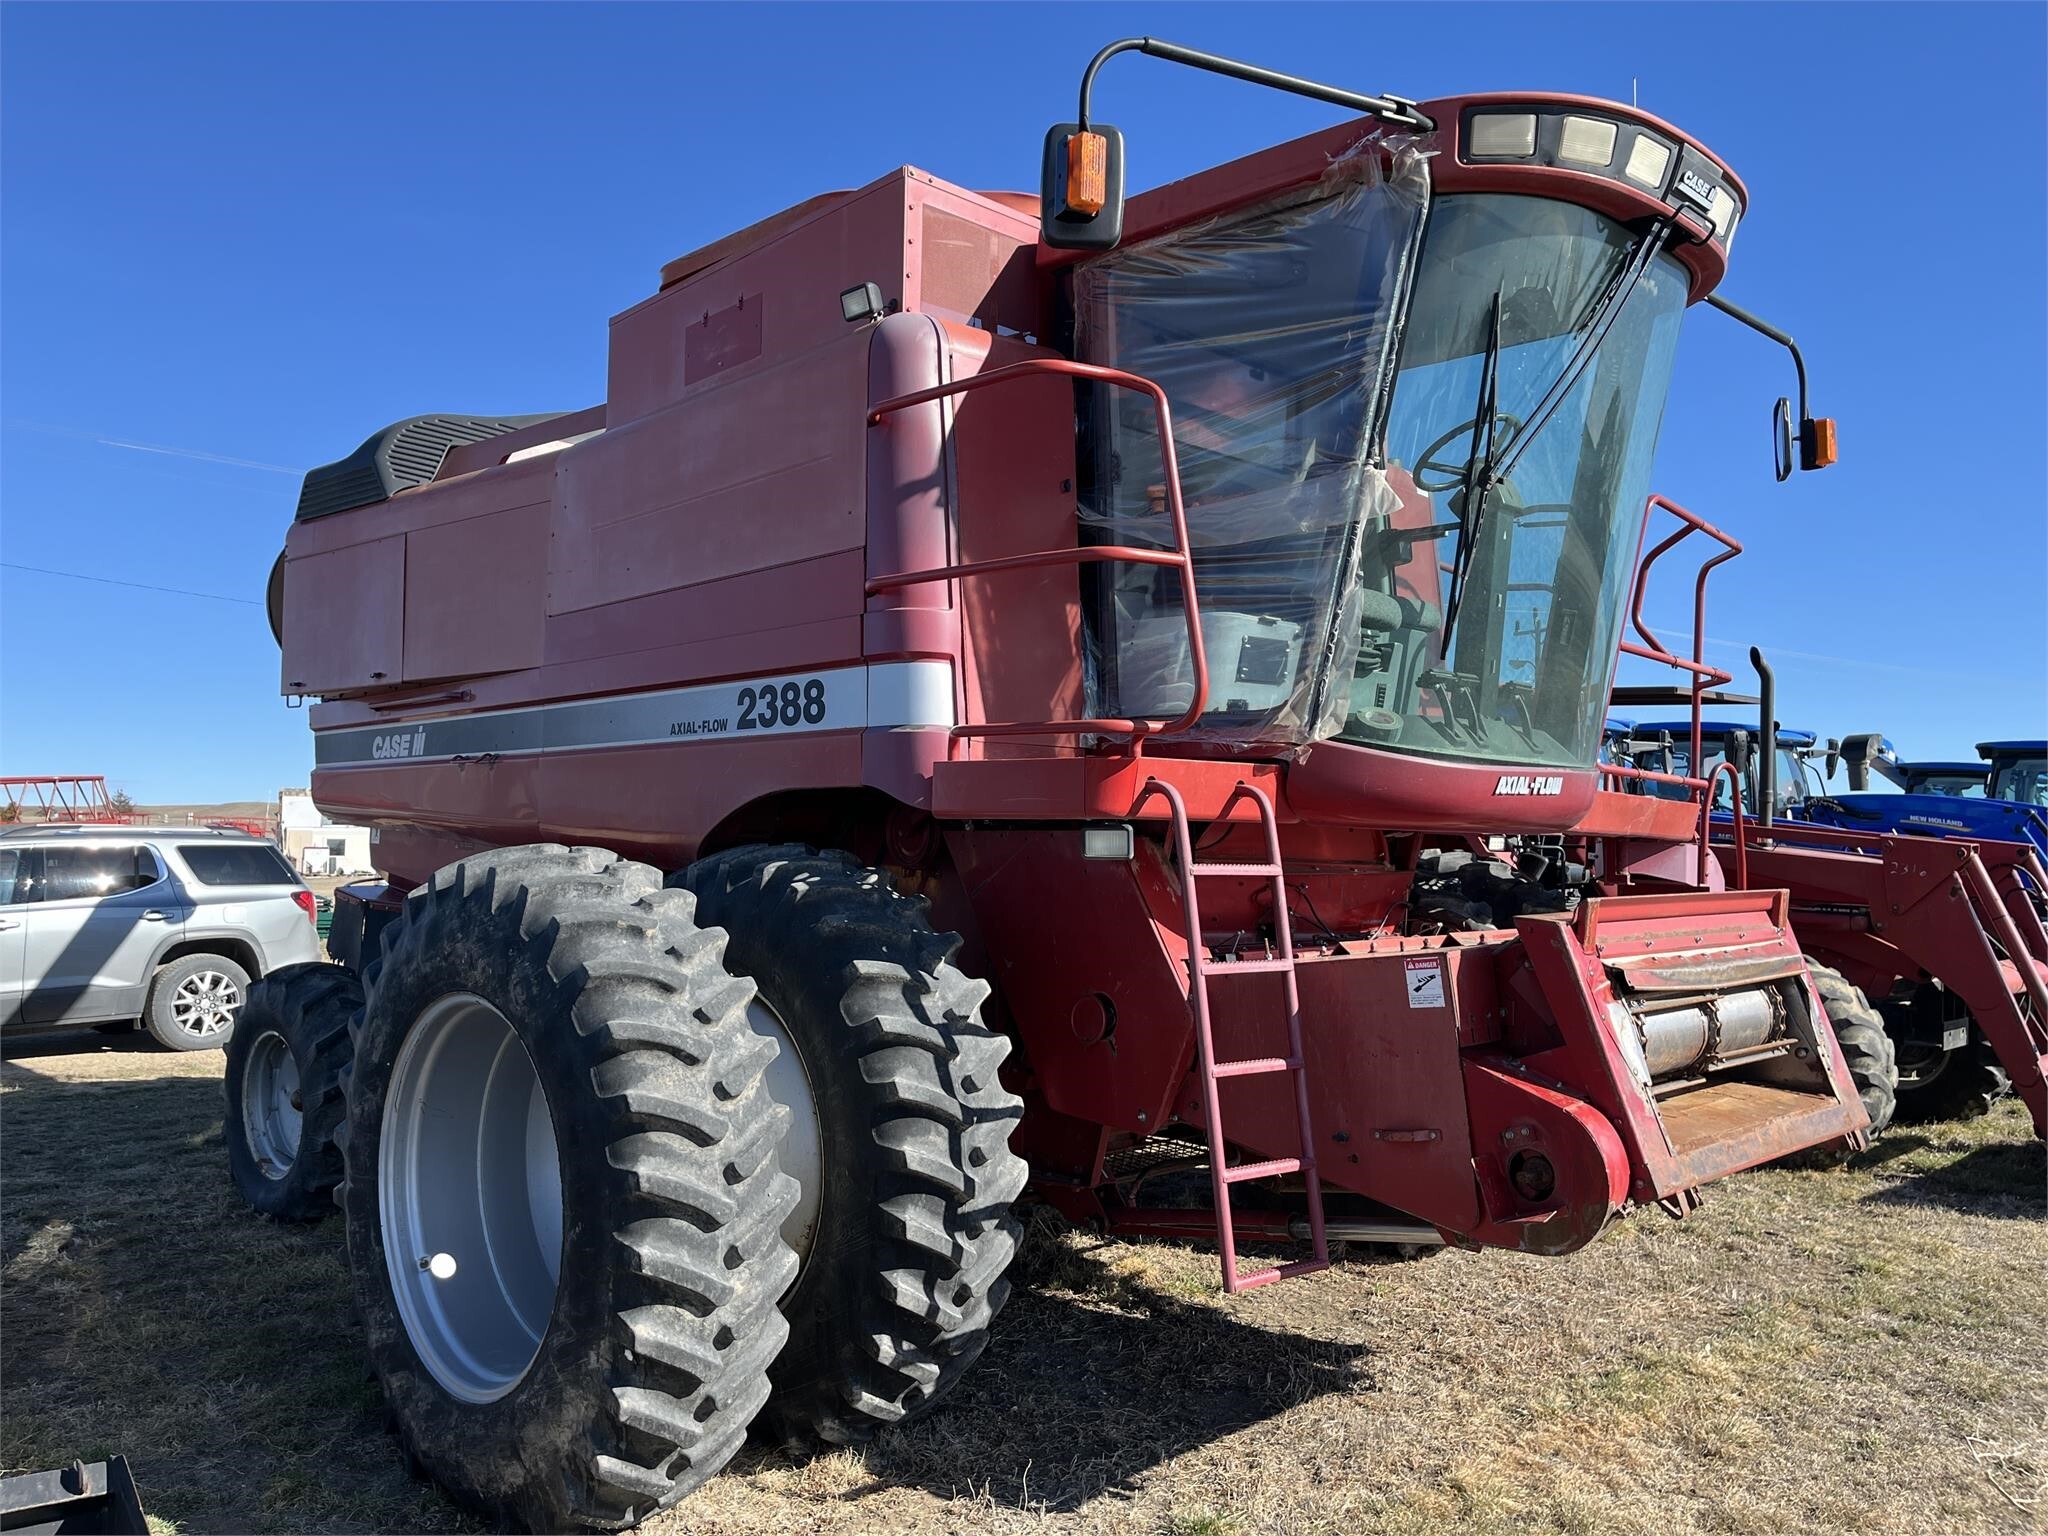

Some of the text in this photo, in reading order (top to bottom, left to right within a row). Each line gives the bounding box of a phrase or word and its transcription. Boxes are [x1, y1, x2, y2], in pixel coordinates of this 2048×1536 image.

[1683, 170, 1710, 198] CASE
[736, 678, 826, 730] 2388
[372, 734, 411, 759] CASE
[1909, 814, 1963, 827] NEW HOLLAND
[1414, 961, 1438, 970] DANGER
